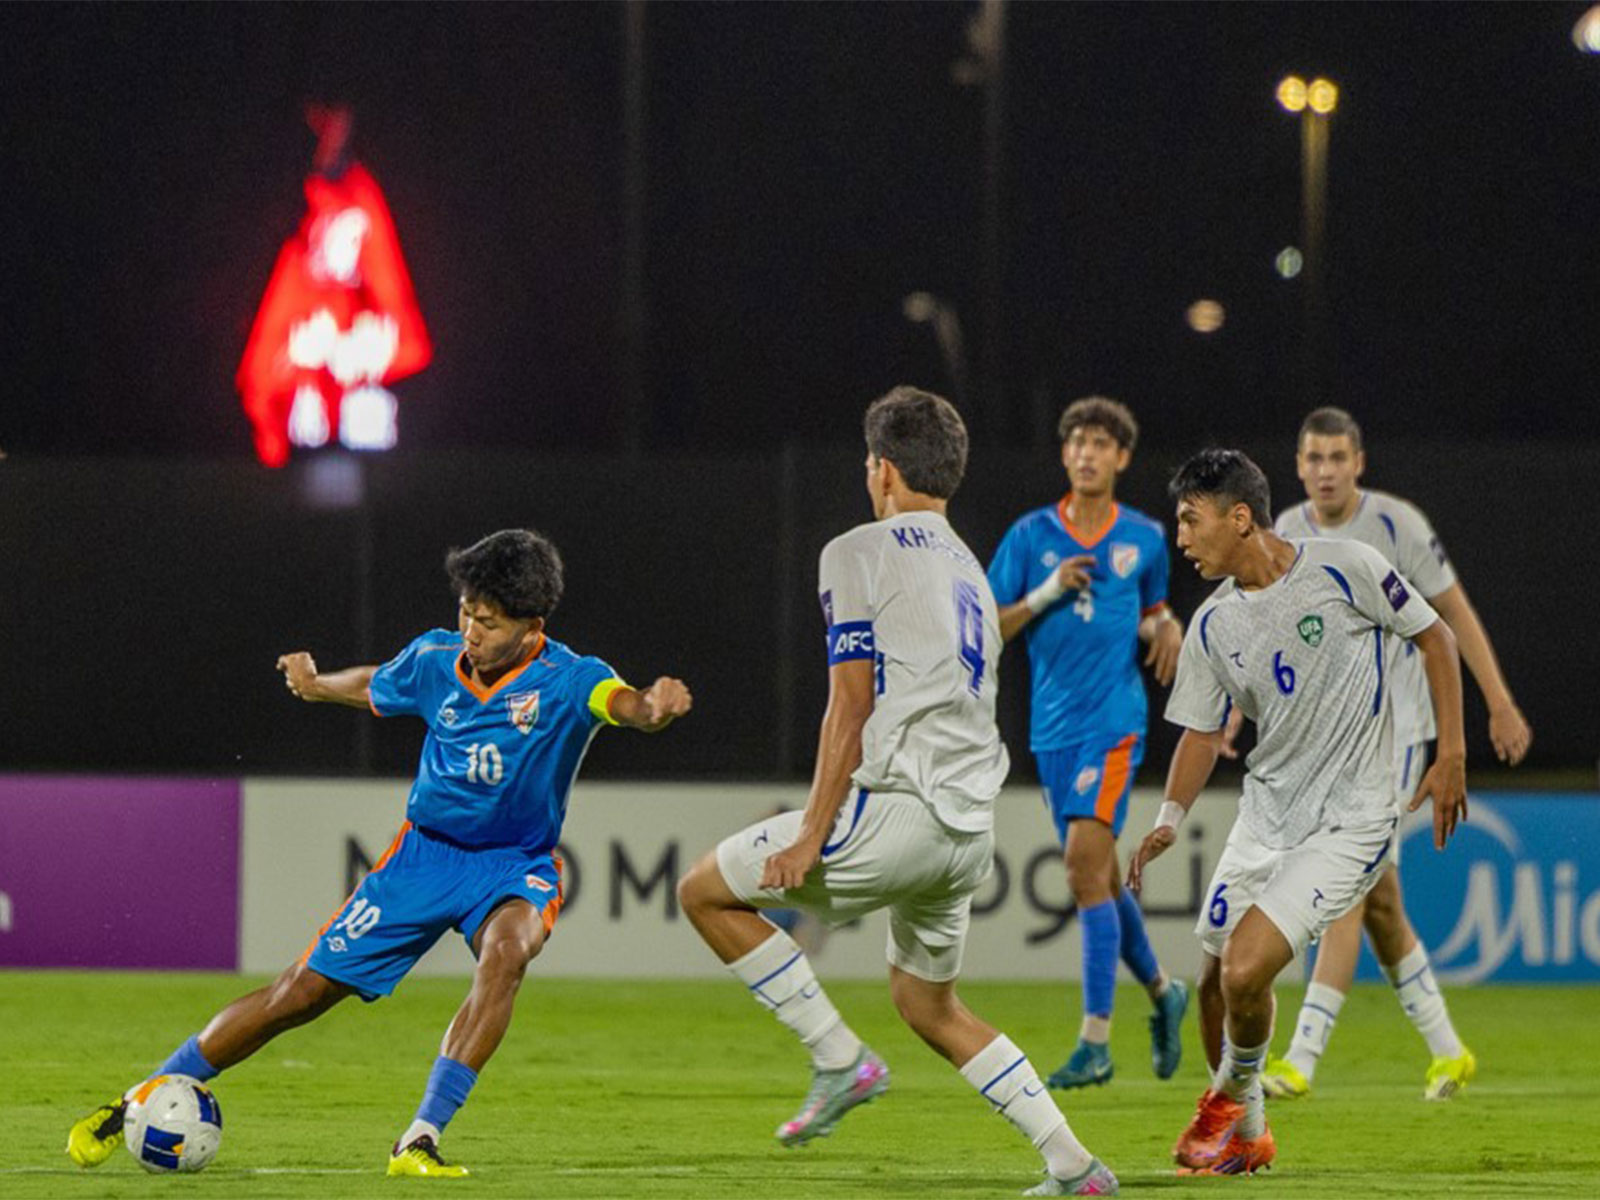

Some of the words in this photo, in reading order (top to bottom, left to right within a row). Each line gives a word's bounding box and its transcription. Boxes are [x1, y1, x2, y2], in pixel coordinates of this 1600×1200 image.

[833, 630, 873, 655] AFC
[1272, 650, 1296, 696] 6
[464, 743, 503, 786] 10
[335, 897, 382, 940] 10
[1208, 883, 1229, 928] 6
